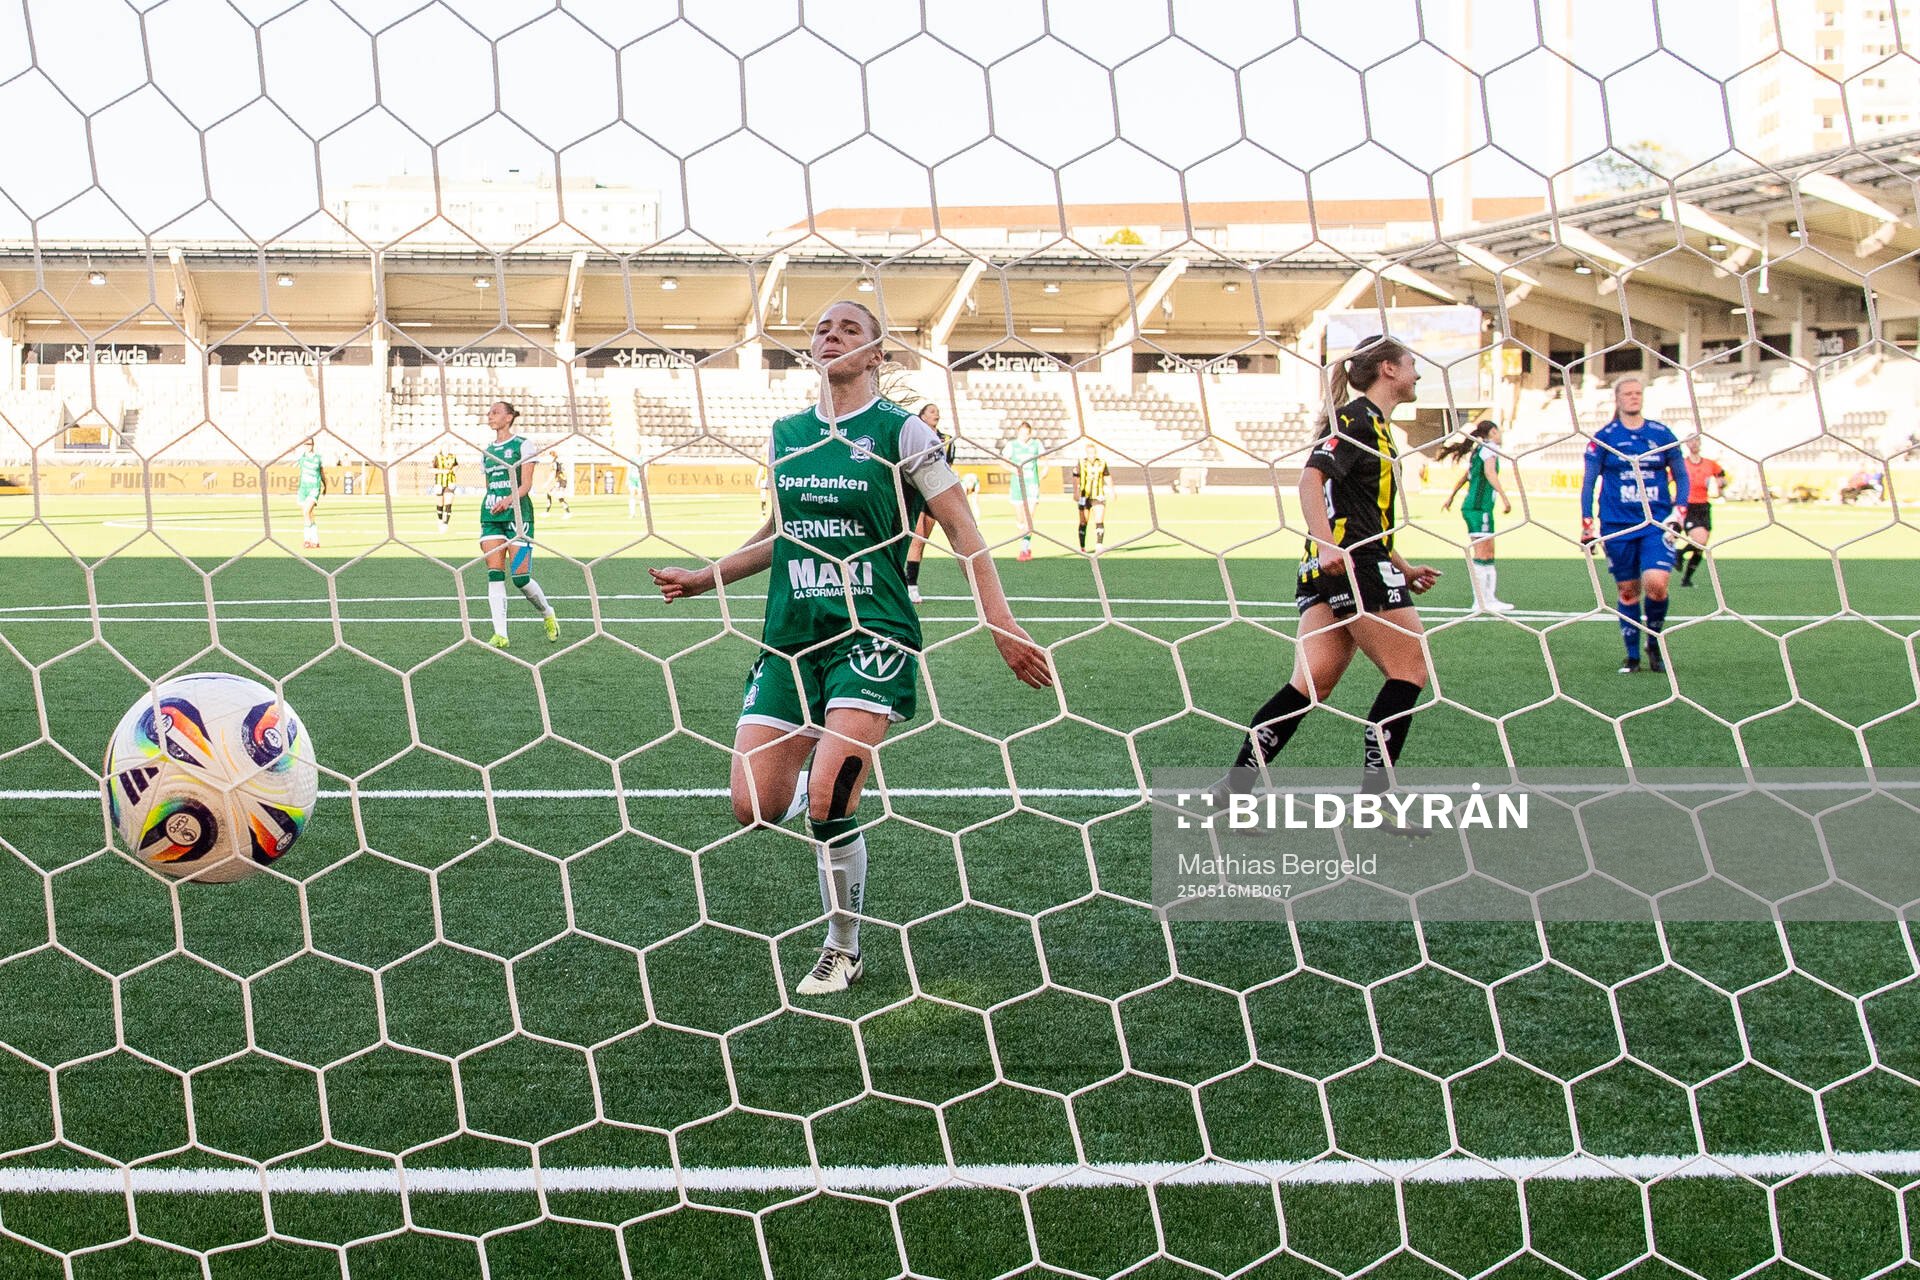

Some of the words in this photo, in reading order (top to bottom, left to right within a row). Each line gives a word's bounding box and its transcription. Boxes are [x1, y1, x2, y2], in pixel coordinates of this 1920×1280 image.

[995, 353, 1060, 372] bravida
[667, 473, 724, 486] GEVAB
[778, 474, 868, 491] Sparbanken
[800, 493, 839, 504] Alingsås
[784, 518, 866, 539] SERNEKE
[787, 558, 873, 590] MAXI
